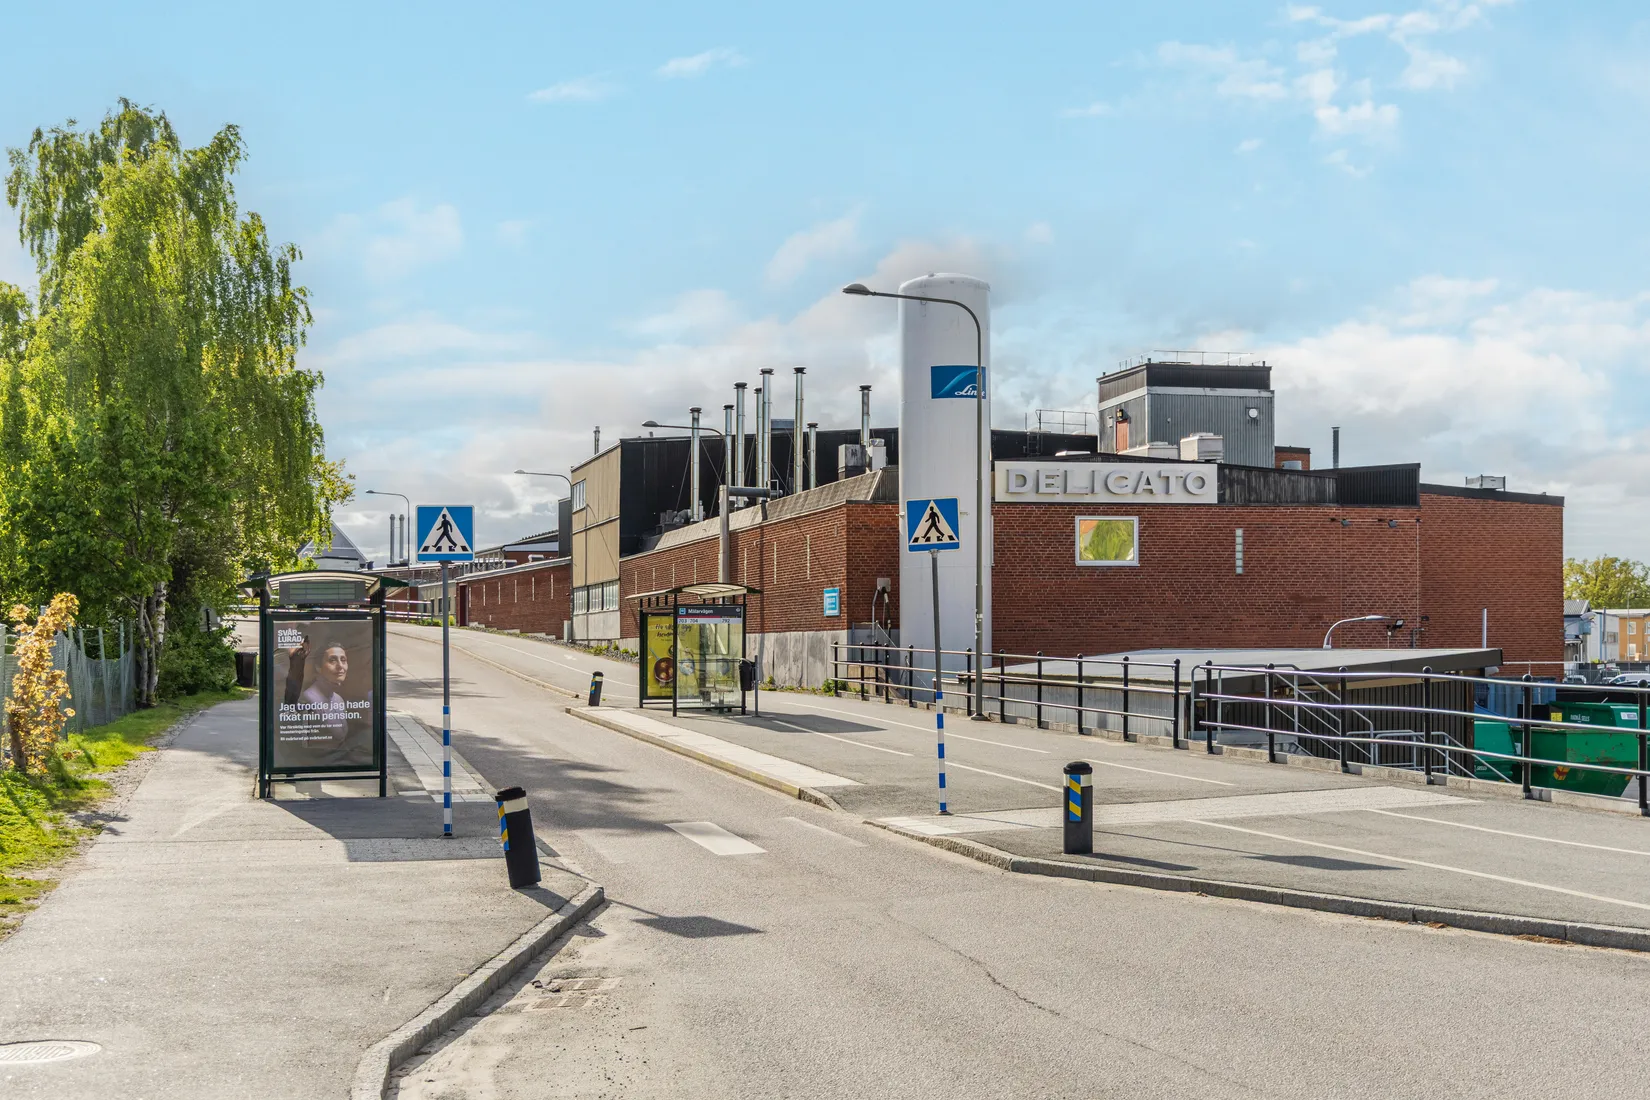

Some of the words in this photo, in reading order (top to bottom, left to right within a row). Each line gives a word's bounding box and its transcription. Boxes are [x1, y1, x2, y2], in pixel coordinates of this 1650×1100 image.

[955, 384, 985, 396] Line
[1006, 468, 1209, 495] DELICATO
[278, 628, 302, 636] SVÅR-
[279, 702, 296, 712] Jag
[297, 702, 328, 710] trodde
[330, 702, 345, 712] jag
[346, 700, 370, 708] hade
[280, 712, 301, 721] fixat
[302, 712, 320, 720] min
[322, 711, 362, 721] pension.
